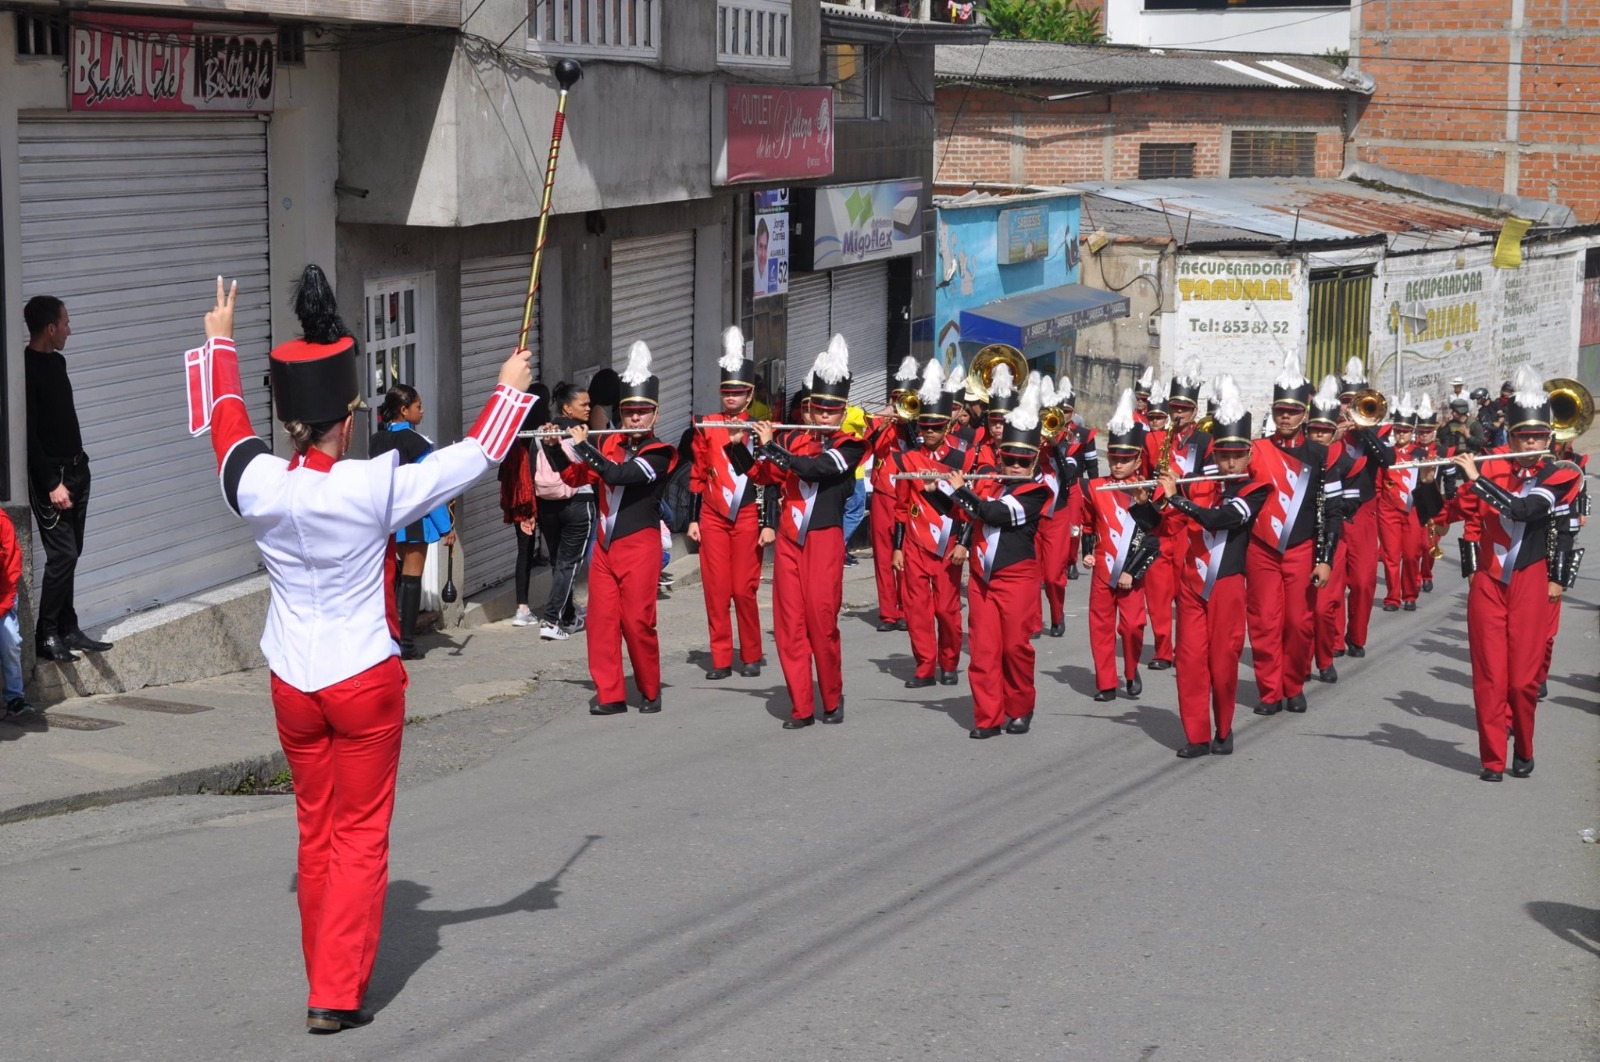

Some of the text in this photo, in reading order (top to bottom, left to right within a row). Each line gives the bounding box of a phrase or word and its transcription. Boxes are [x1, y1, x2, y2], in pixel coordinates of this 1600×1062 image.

[74, 29, 181, 95] BLANCO
[87, 56, 270, 109] Sala de Belleza
[741, 94, 773, 125] OUTLET
[773, 90, 812, 159] Belleza
[842, 227, 893, 260] Migoflex
[778, 261, 788, 284] 52
[1180, 261, 1292, 275] RECUPERADORA
[1178, 278, 1293, 301] YARUMAL
[1405, 270, 1482, 302] RECUPERADORA
[1189, 318, 1289, 334] Tel: 853 82 52
[1404, 301, 1479, 346] YRUMAL
